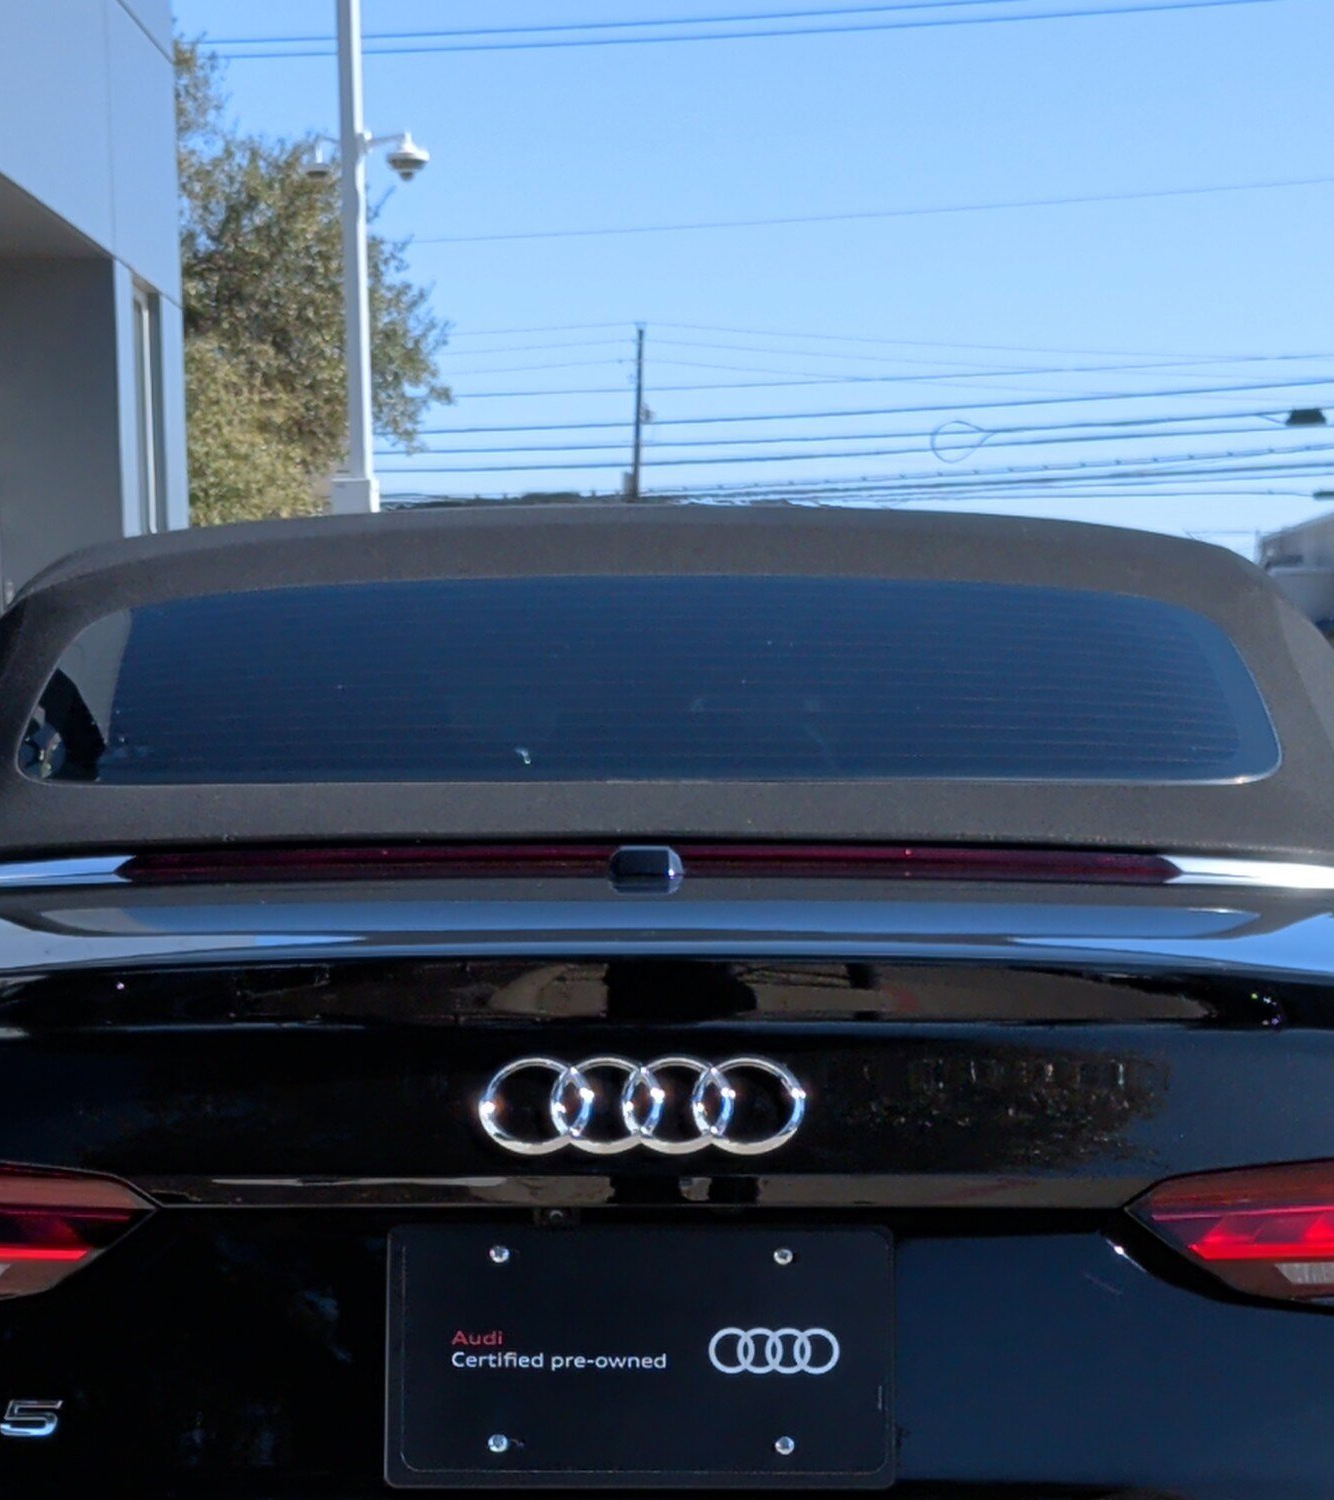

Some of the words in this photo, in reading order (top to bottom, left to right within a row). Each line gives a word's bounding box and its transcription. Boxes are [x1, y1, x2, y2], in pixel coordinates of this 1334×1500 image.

[452, 1330, 504, 1346] Audi
[451, 1351, 545, 1368] Certified
[551, 1353, 667, 1371] pre-owned
